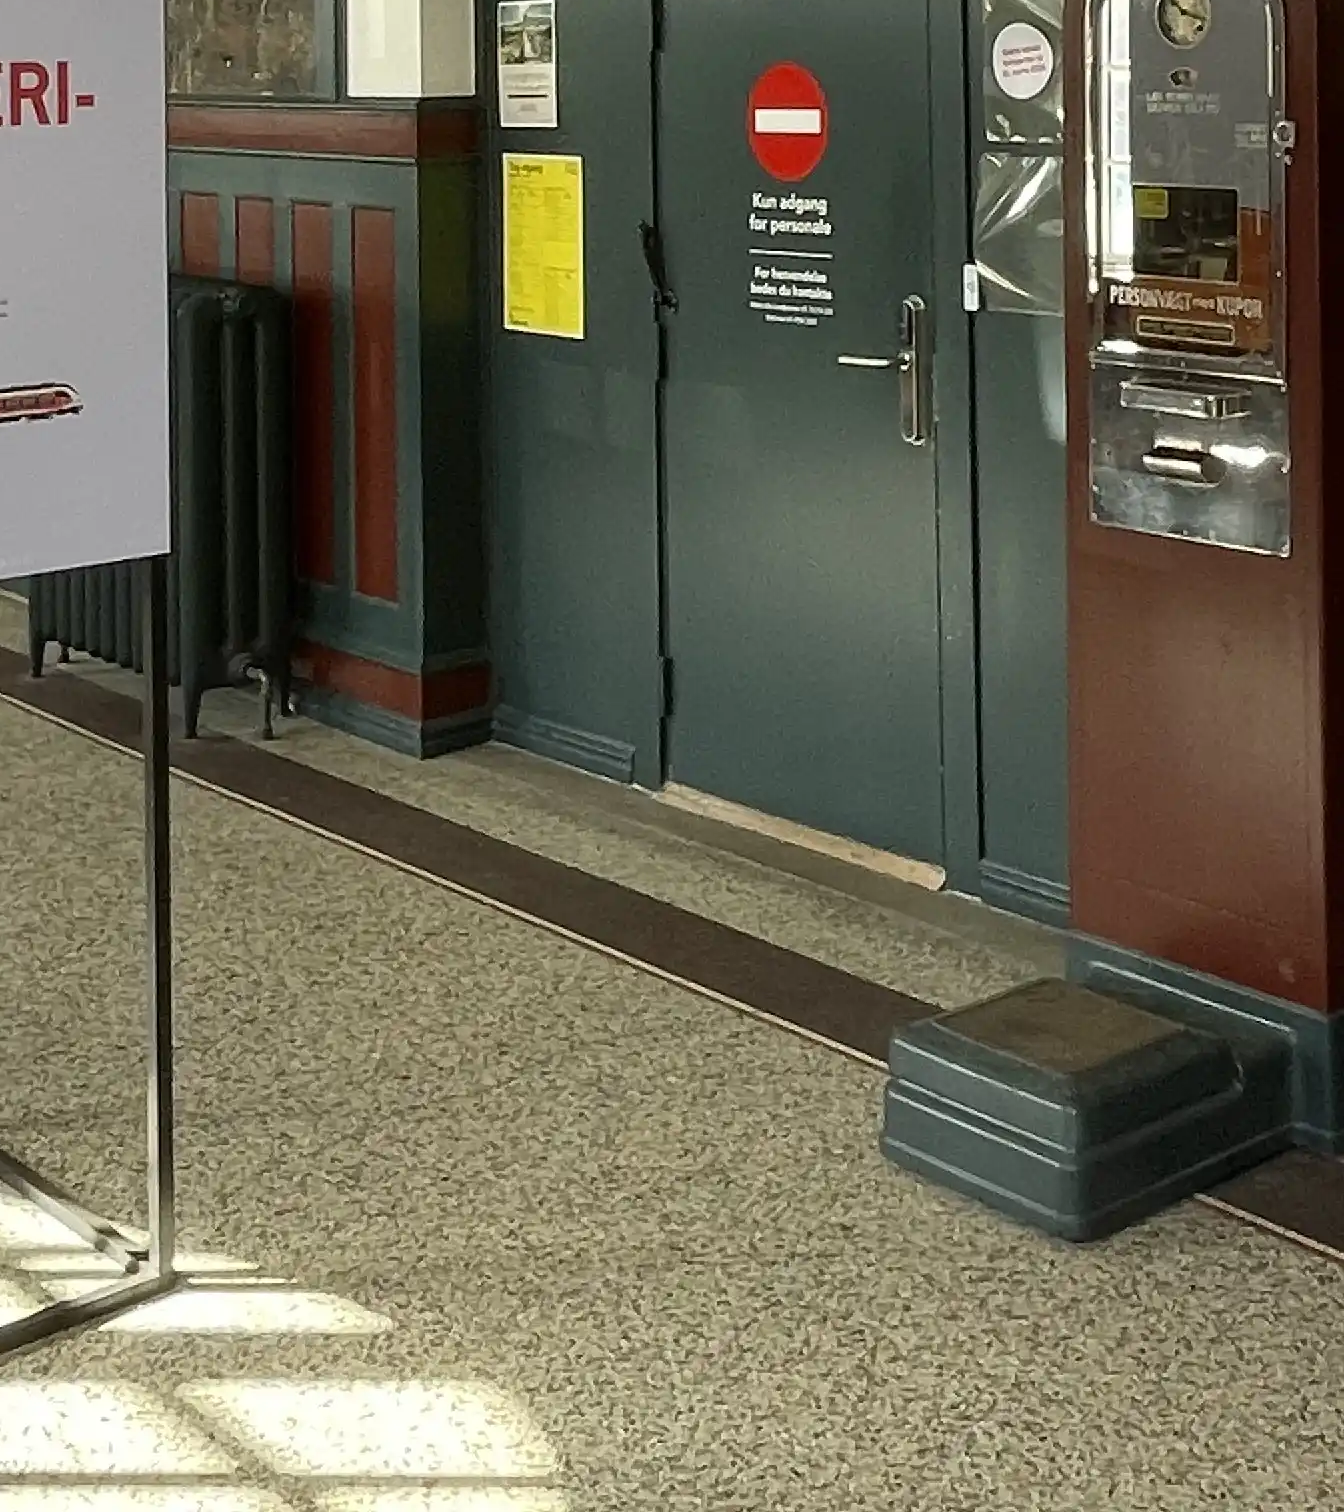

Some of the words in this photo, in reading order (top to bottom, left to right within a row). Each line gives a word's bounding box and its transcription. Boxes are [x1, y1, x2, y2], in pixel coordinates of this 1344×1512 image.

[752, 192, 777, 208] Kun
[779, 192, 827, 215] adgang
[749, 213, 767, 230] for
[771, 219, 832, 236] personale
